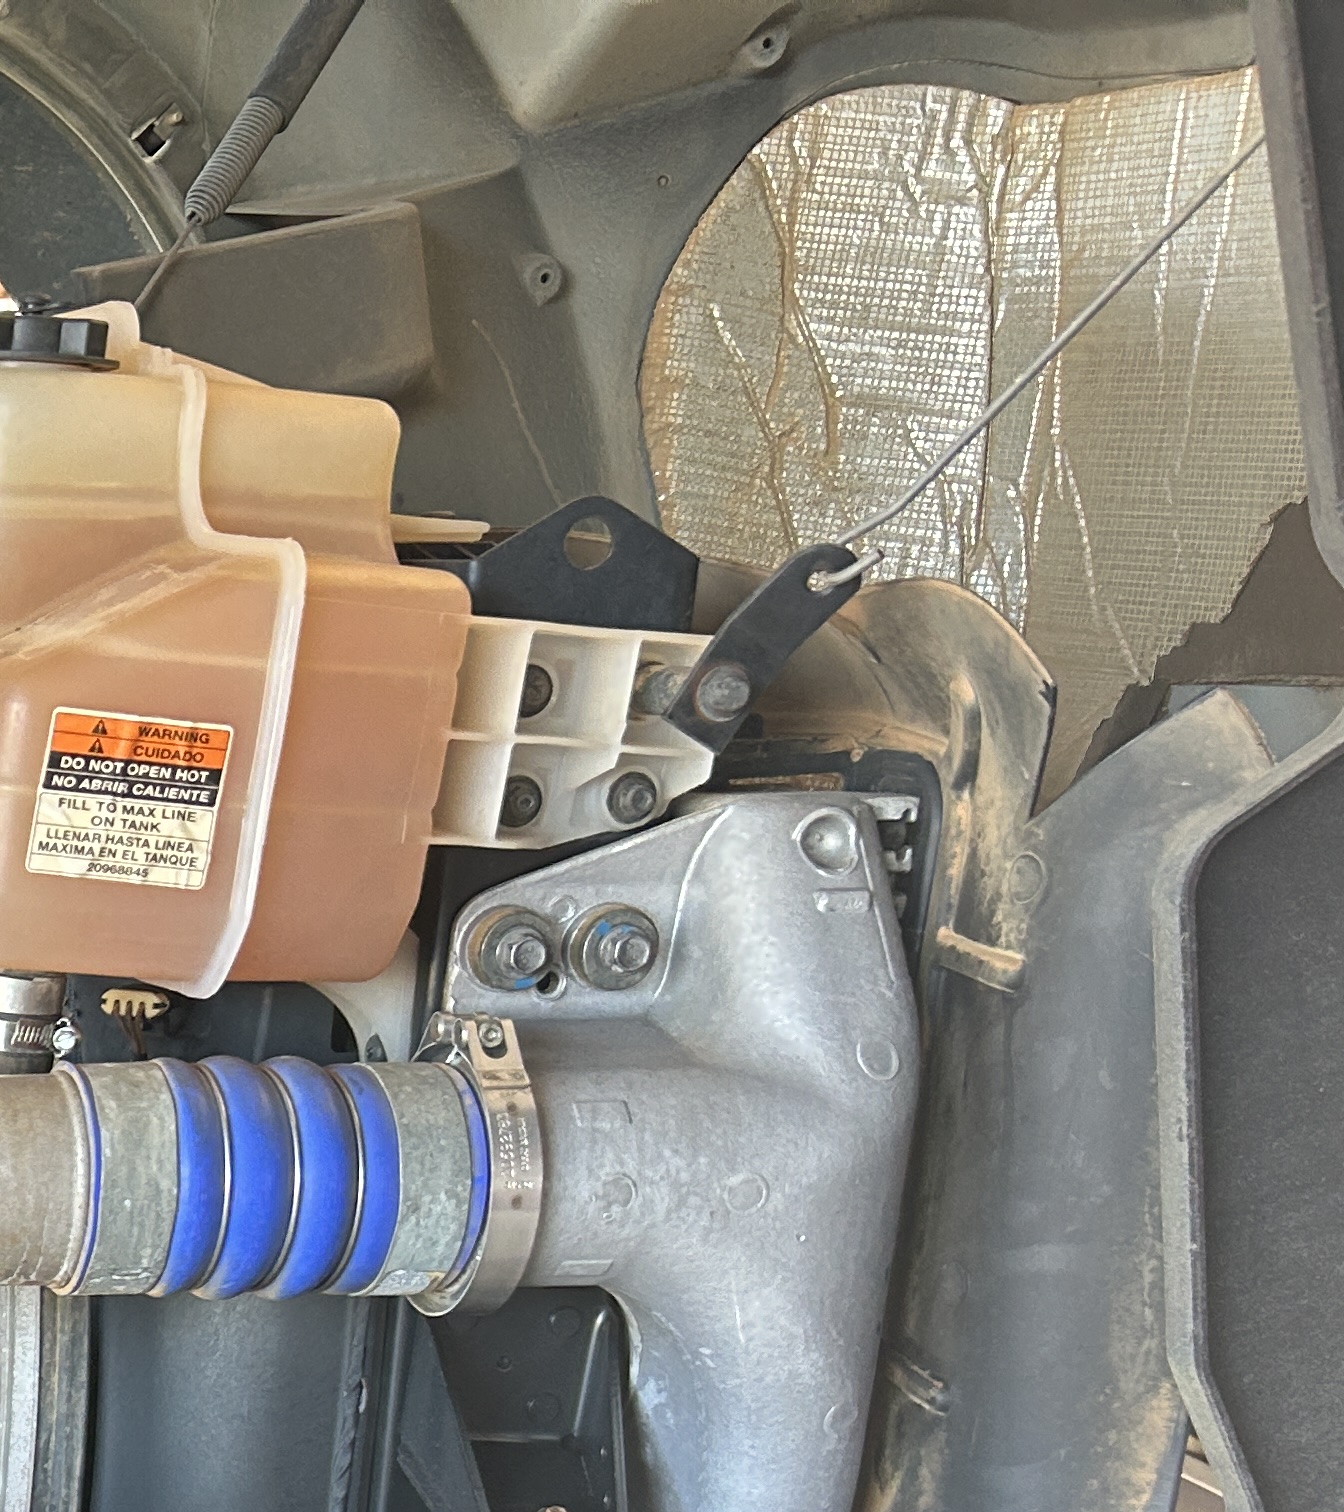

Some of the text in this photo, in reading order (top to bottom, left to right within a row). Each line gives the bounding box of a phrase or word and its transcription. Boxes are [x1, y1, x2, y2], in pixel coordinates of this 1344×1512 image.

[138, 726, 210, 744] WARNING
[133, 745, 205, 763] CUIDADO
[60, 756, 209, 782] DO NOT OPEN HOT
[52, 775, 210, 802] NO ABRIR CALIENTE
[58, 797, 197, 822] FILL TO MAX LINE
[91, 815, 161, 833] ON TANK
[46, 828, 194, 853] LLENAR HASTA LINEA
[38, 841, 198, 867] MAXIMA EN EL TANQUE
